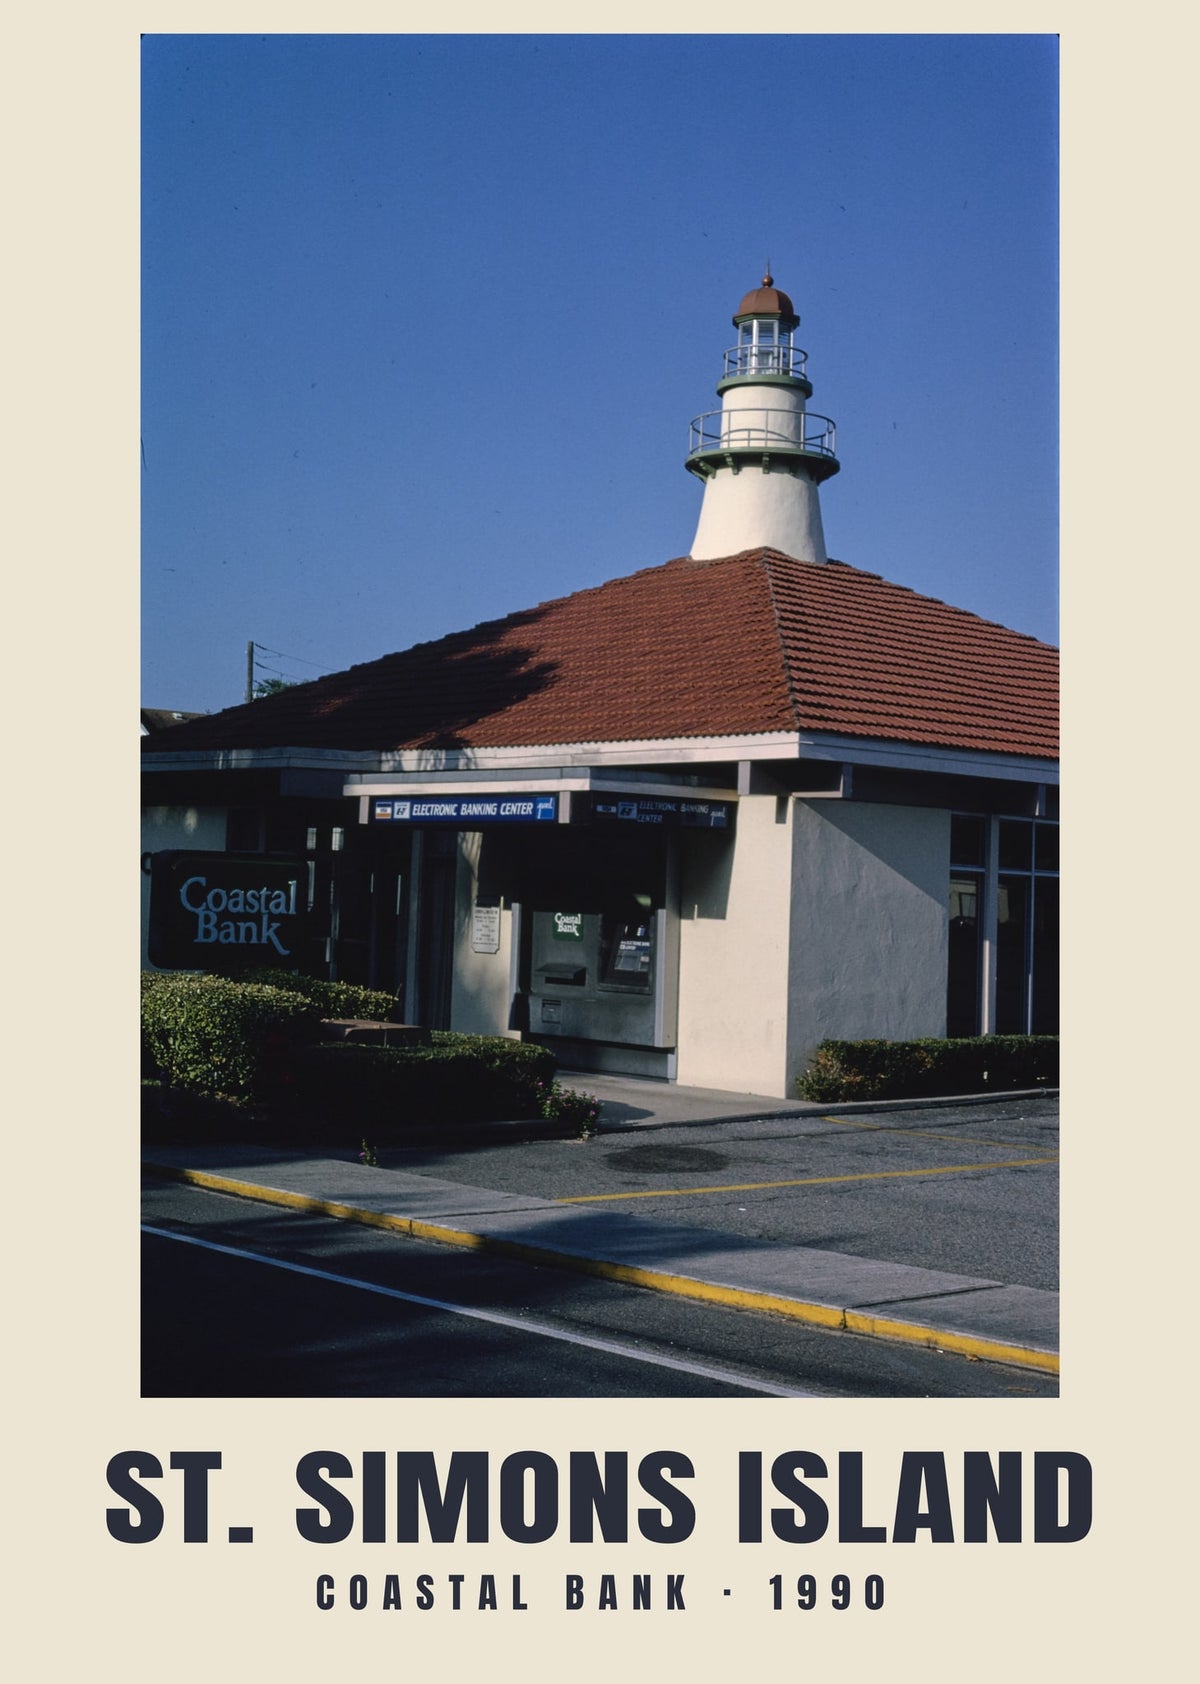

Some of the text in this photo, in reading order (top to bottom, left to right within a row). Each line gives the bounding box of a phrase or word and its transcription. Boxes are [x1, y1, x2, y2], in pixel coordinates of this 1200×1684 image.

[412, 803, 457, 817] ELECTRONIC
[460, 802, 498, 816] BANKING
[500, 801, 534, 816] CENTER
[179, 876, 297, 915] Coastal
[554, 912, 582, 925] Coastal
[193, 910, 291, 956] Bank
[557, 922, 580, 937] Bank
